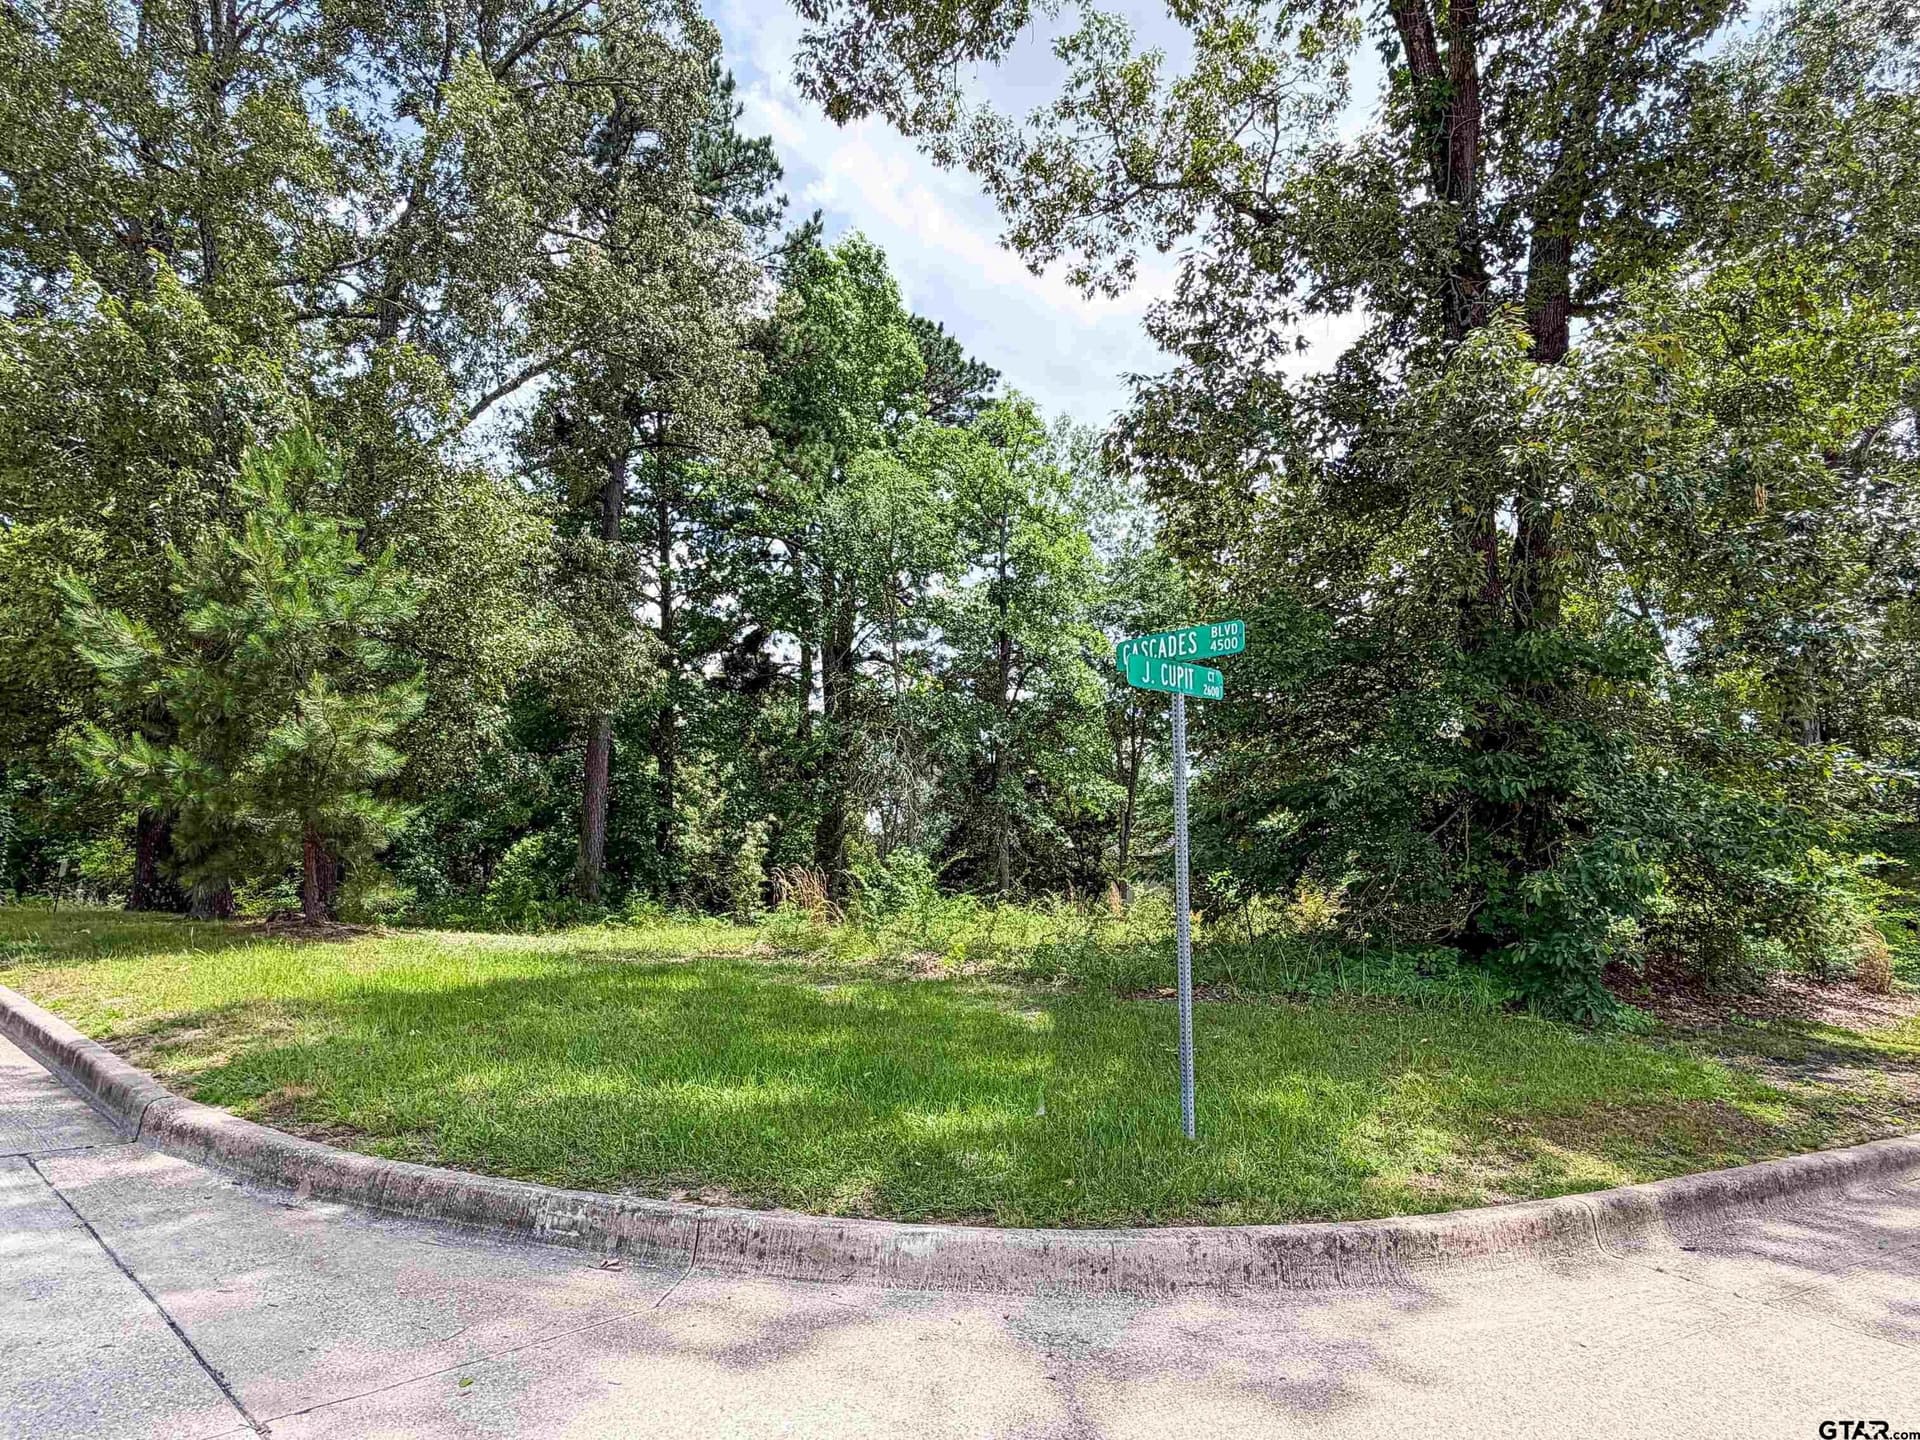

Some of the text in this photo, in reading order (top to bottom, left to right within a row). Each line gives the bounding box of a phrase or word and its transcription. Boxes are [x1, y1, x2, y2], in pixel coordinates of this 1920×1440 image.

[1123, 623, 1238, 666] CASCADES BLVD
[1210, 637, 1238, 651] 4500
[1142, 660, 1215, 690] J. CUPIT CT
[1203, 684, 1219, 698] 2600
